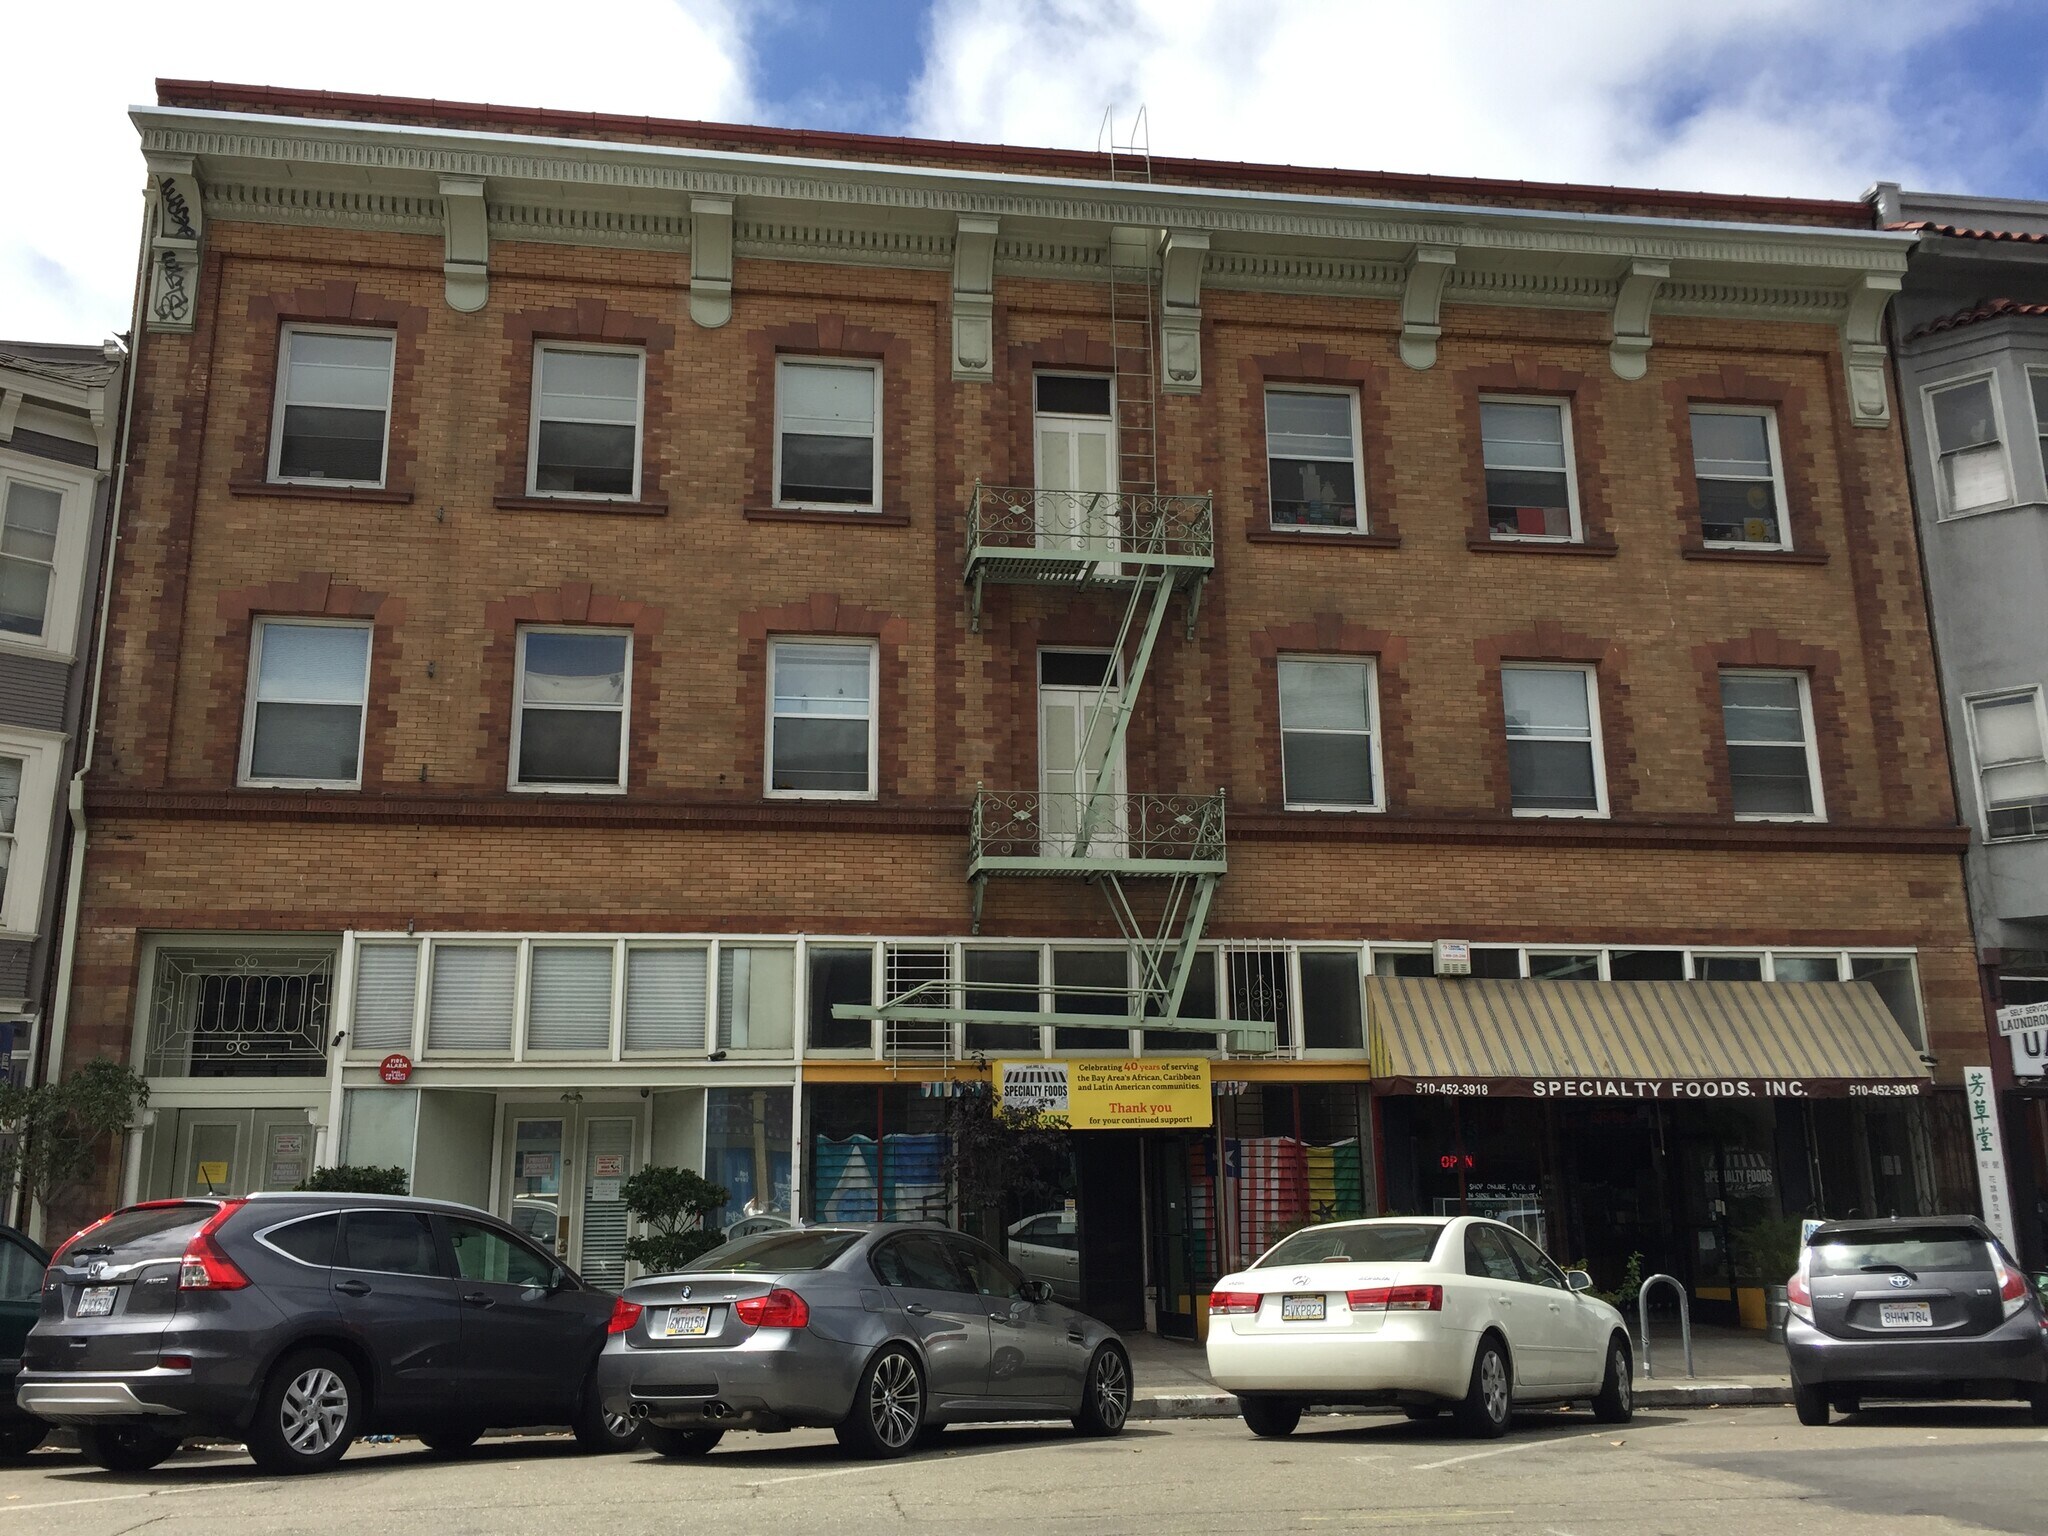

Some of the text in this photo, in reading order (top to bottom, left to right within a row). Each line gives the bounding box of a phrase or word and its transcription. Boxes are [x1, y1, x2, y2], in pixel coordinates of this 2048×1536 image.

[2009, 1008, 2023, 1017] SELF
[1079, 1063, 1122, 1072] Celebrating
[1124, 1062, 1138, 1071] 40
[1139, 1064, 1160, 1072] years
[1171, 1063, 1199, 1071] serving
[1091, 1075, 1106, 1083] Bay
[1132, 1074, 1162, 1082] African,
[1163, 1073, 1201, 1081] Caribbean
[1004, 1085, 1068, 1097] SPECIALTY FOODS
[1152, 1082, 1201, 1090] communities.
[1415, 1082, 1489, 1096] 510-452-3918
[1532, 1080, 1661, 1097] SPECIALTY
[1765, 1081, 1808, 1096] INC.
[1849, 1084, 1920, 1096] 510-452-3918
[1109, 1102, 1172, 1115] Thank you
[1968, 1072, 1994, 1152] 芳草堂
[1041, 1114, 1069, 1124] 2017
[1089, 1116, 1193, 1125] for your continued support!
[1440, 1155, 1474, 1168] OPN
[1704, 1169, 1773, 1183] SPEIALTY FOODS
